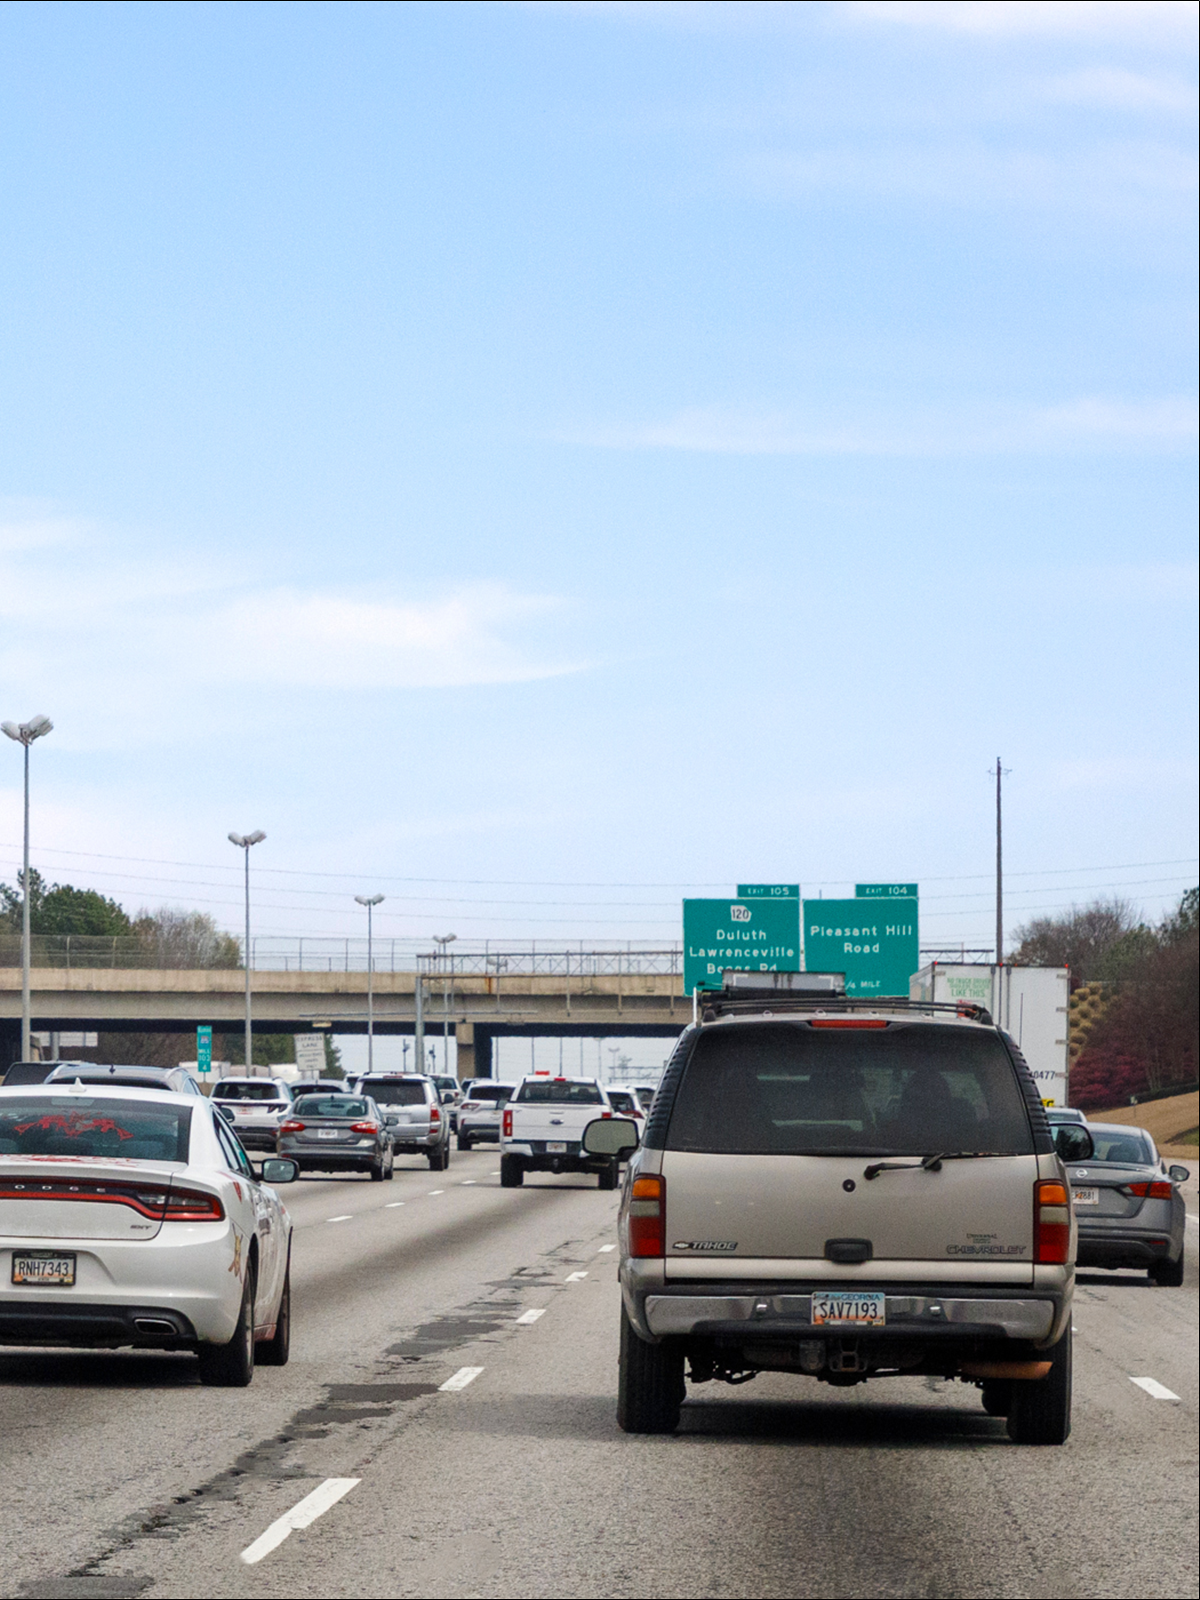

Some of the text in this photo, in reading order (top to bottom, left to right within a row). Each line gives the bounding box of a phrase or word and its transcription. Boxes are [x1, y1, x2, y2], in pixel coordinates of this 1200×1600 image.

[770, 887, 789, 895] 105
[889, 886, 908, 895] 104
[732, 909, 749, 920] 120
[716, 929, 767, 940] Duluth
[810, 925, 912, 937] Pleasant Hill
[689, 946, 795, 957] Lawrenceville
[844, 942, 880, 953] Road
[951, 988, 985, 998] LIKE THIS
[692, 1241, 738, 1250] TAHOE
[946, 1244, 1027, 1255] CHEVROLET
[18, 1261, 70, 1277] RNH7343
[841, 1293, 880, 1301] GEORGIA
[819, 1301, 878, 1319] SAV7193
